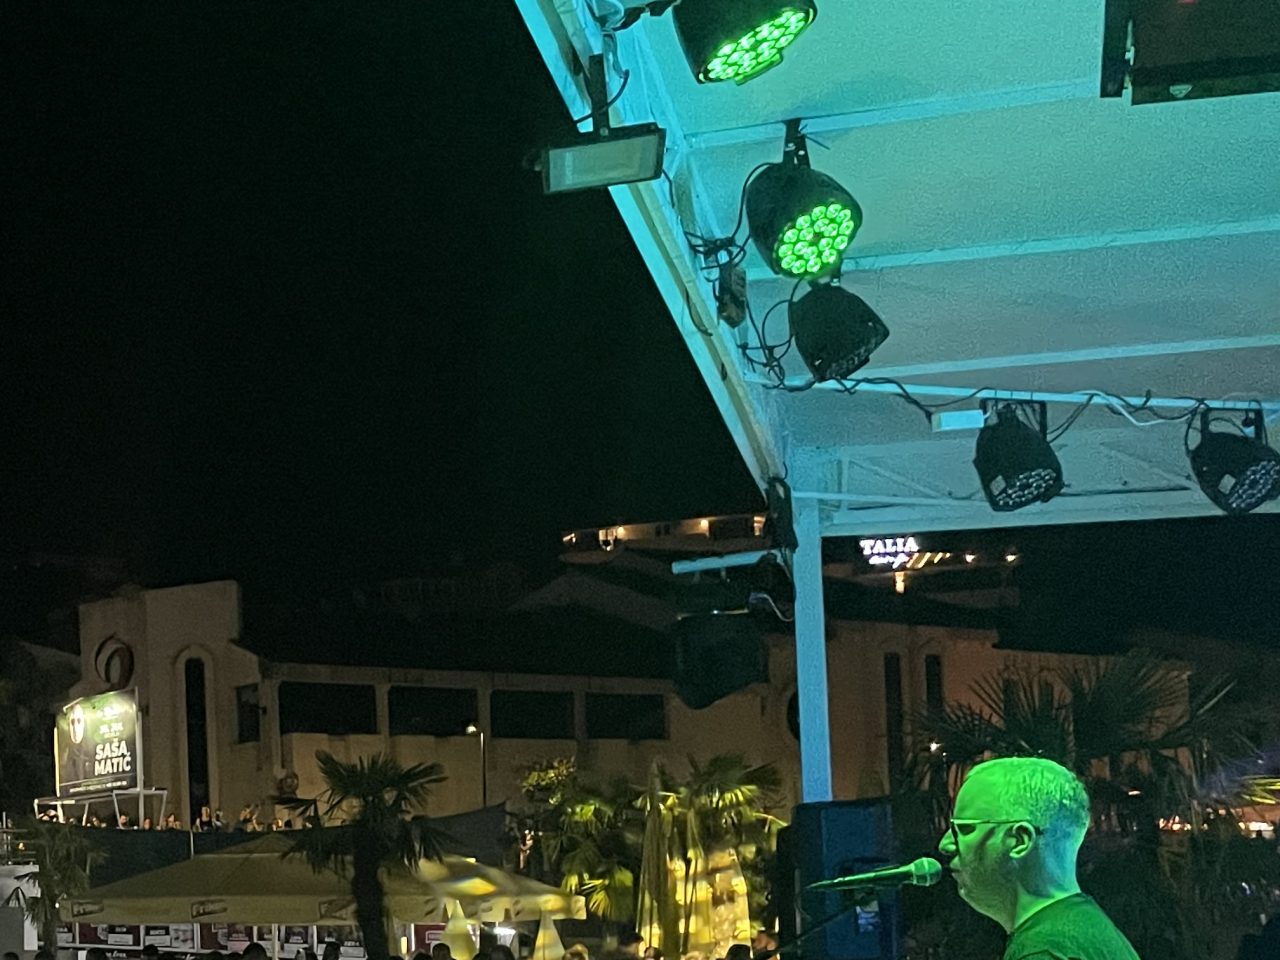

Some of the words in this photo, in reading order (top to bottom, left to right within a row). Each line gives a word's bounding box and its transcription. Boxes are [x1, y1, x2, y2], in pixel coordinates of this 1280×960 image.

[860, 537, 919, 555] TALIA
[96, 738, 128, 761] SAŠA
[94, 752, 132, 776] MATIĆ
